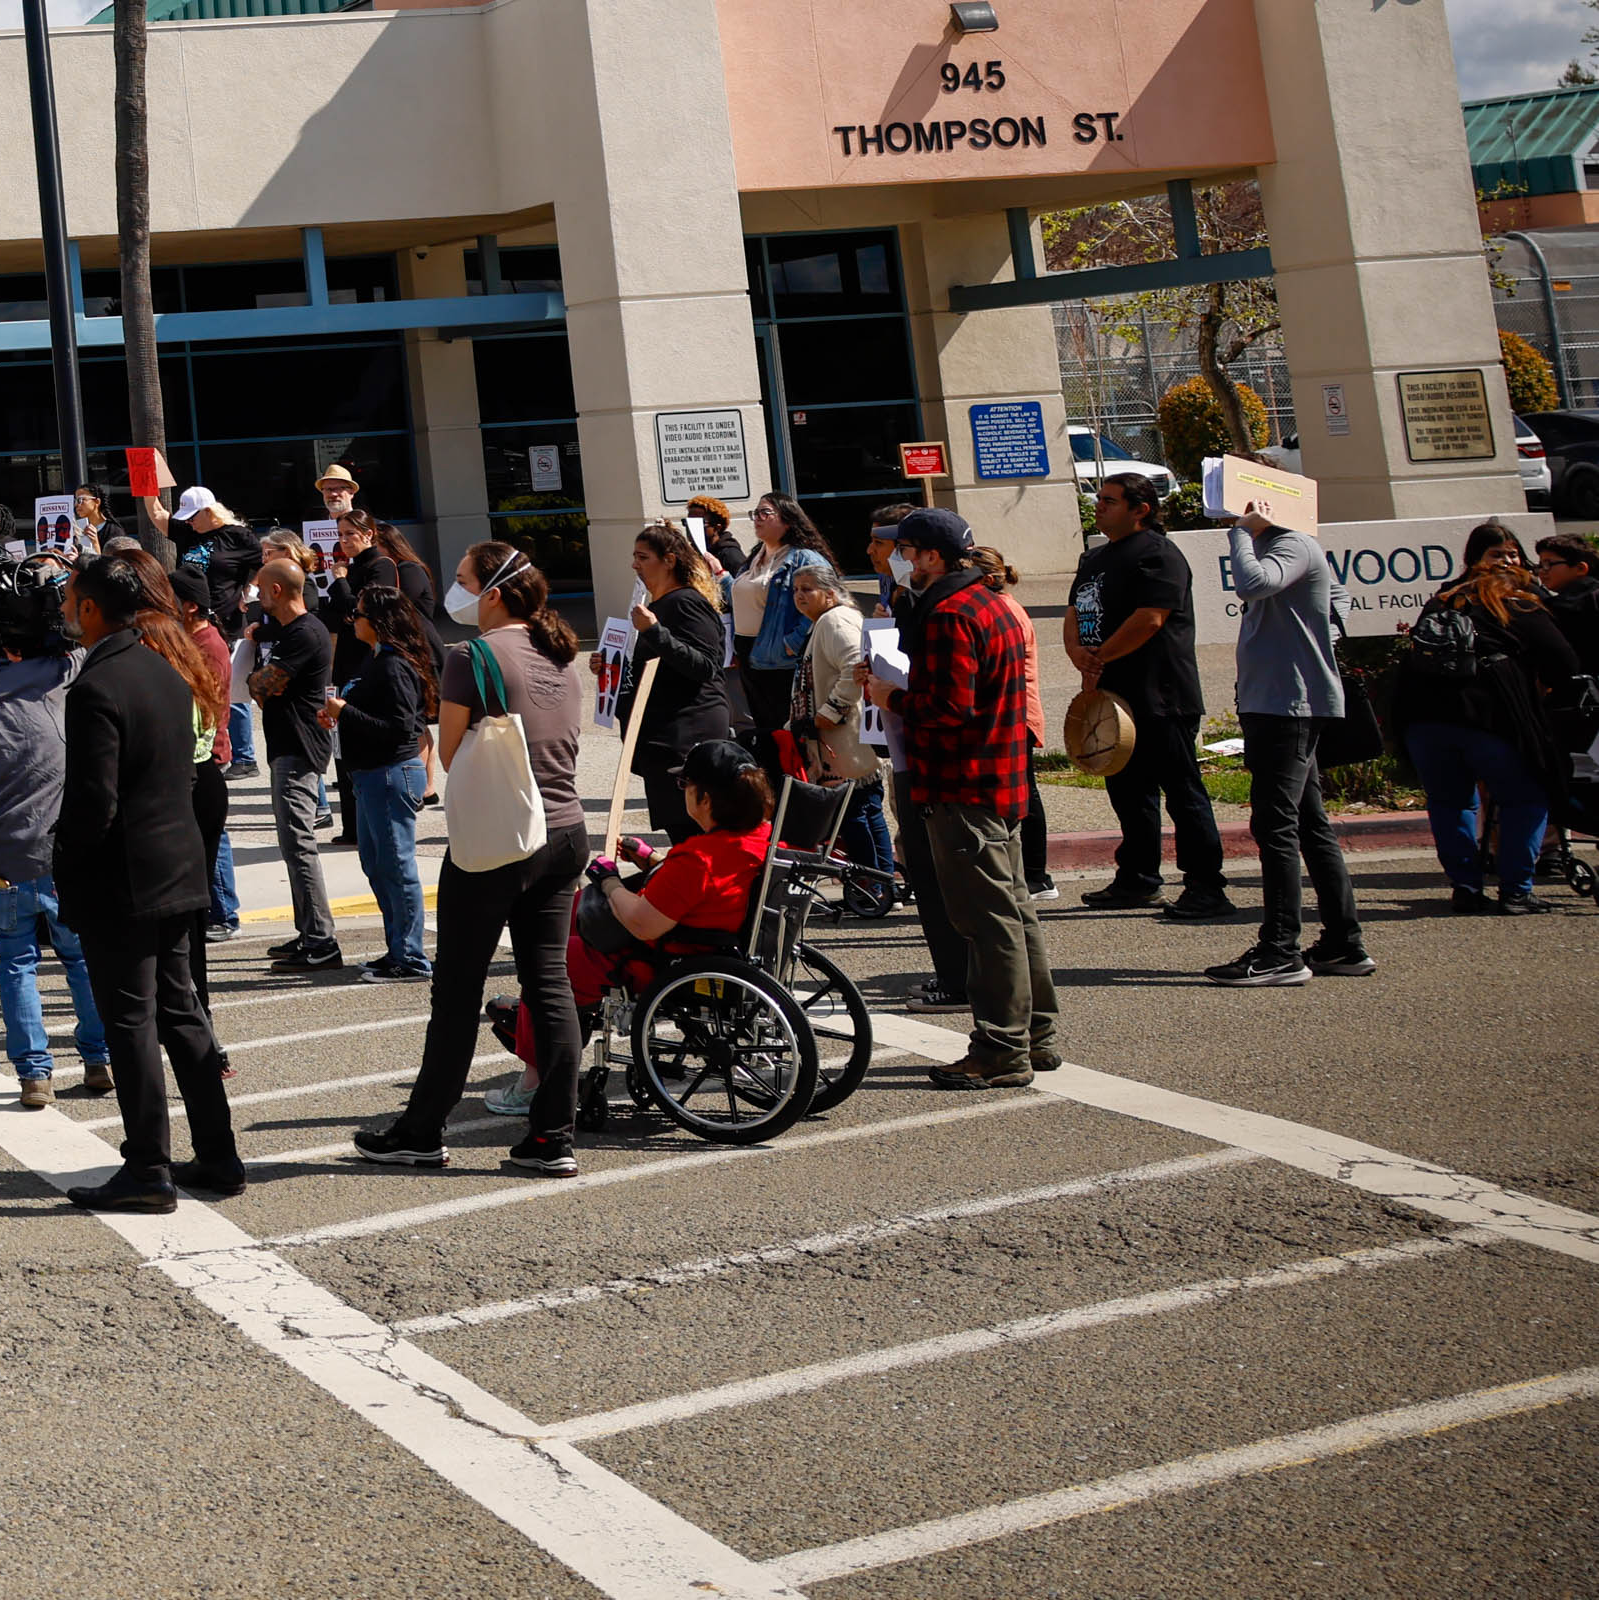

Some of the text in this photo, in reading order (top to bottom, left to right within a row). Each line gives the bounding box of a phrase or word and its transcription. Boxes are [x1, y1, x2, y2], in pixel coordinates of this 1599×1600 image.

[940, 60, 1005, 92] 945
[834, 112, 1124, 155] THOMPSON ST.
[705, 431, 737, 439] RECORDING
[1219, 545, 1454, 591] EWOOD
[1380, 593, 1432, 609] FACIL
